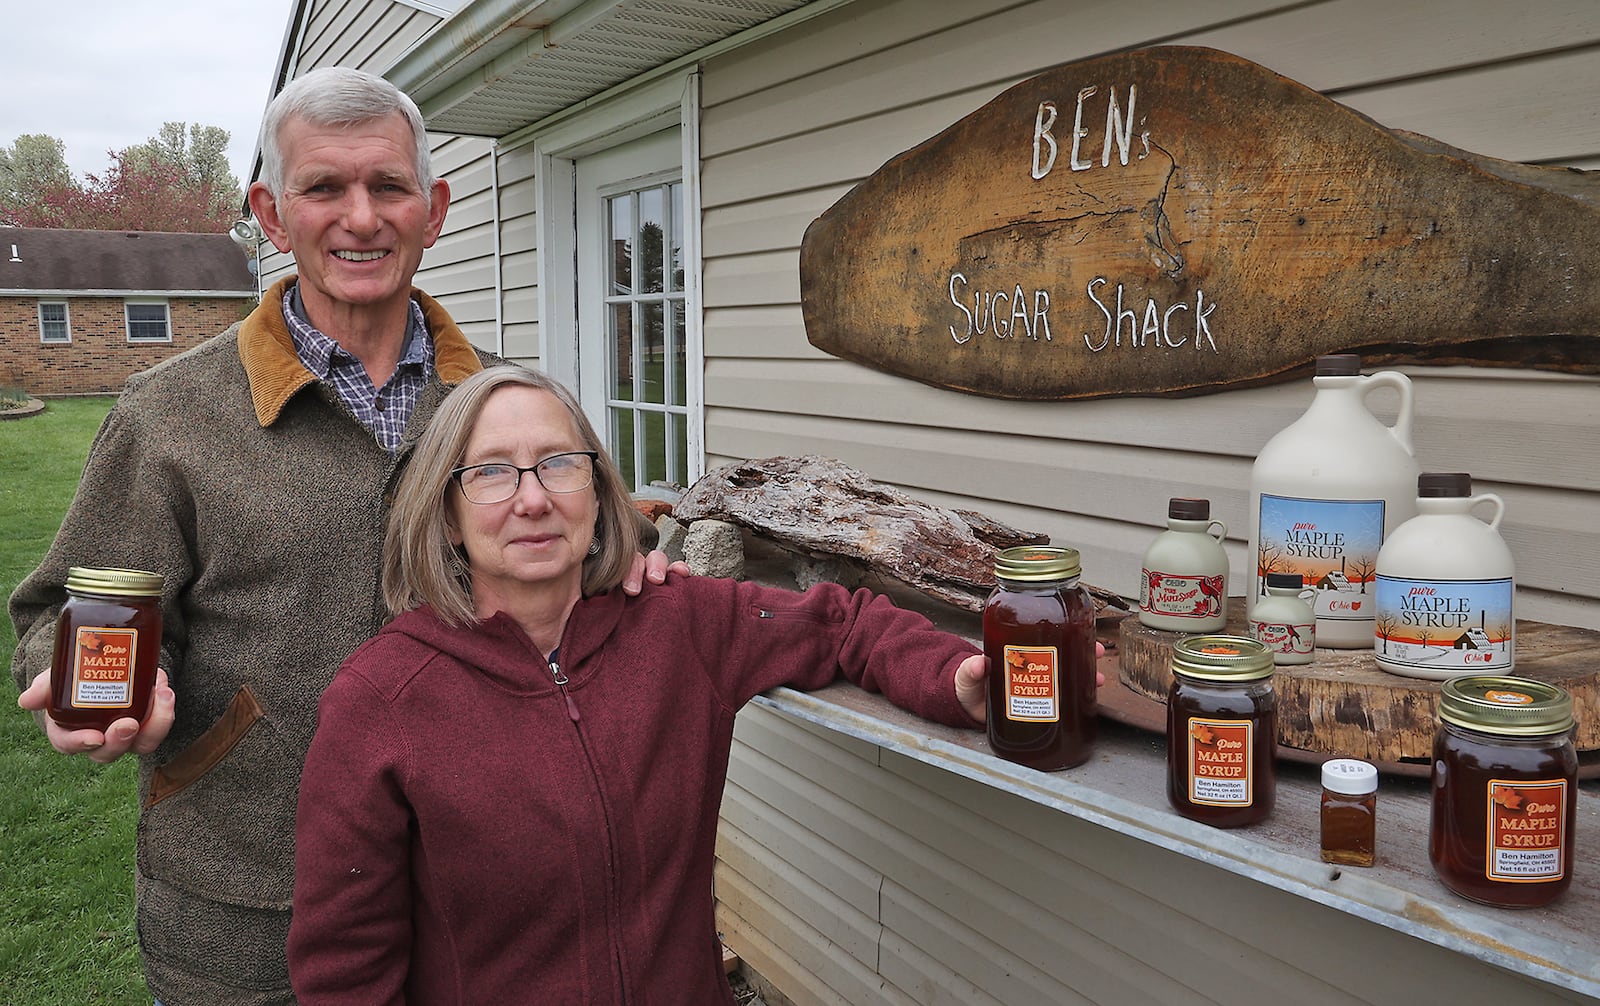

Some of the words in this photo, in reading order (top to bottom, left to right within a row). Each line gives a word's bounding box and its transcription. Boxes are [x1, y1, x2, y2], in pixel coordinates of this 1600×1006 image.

[949, 271, 1052, 345] SUGAR
[1292, 522, 1317, 532] pure
[1285, 529, 1345, 546] MAPLE
[1286, 544, 1343, 560] SYRUP
[1408, 586, 1438, 598] pure
[1329, 600, 1351, 612] Ohio
[1400, 595, 1471, 613] MAPLE
[1402, 611, 1469, 628] SYRUP
[103, 644, 127, 656] Pure
[83, 656, 127, 667] MAPLE
[1464, 653, 1484, 664] Ohio
[1027, 663, 1049, 673] Pure
[83, 669, 125, 680] SYRUP
[1012, 673, 1050, 684] MAPLE
[1013, 685, 1049, 696] SYRUP
[1216, 738, 1242, 750] Pure
[1197, 750, 1243, 763] MAPLE
[1199, 764, 1242, 777] SYRUP
[1526, 802, 1556, 816] Pure
[1500, 817, 1557, 830] MAPLE
[1502, 834, 1555, 846] SYRUP
